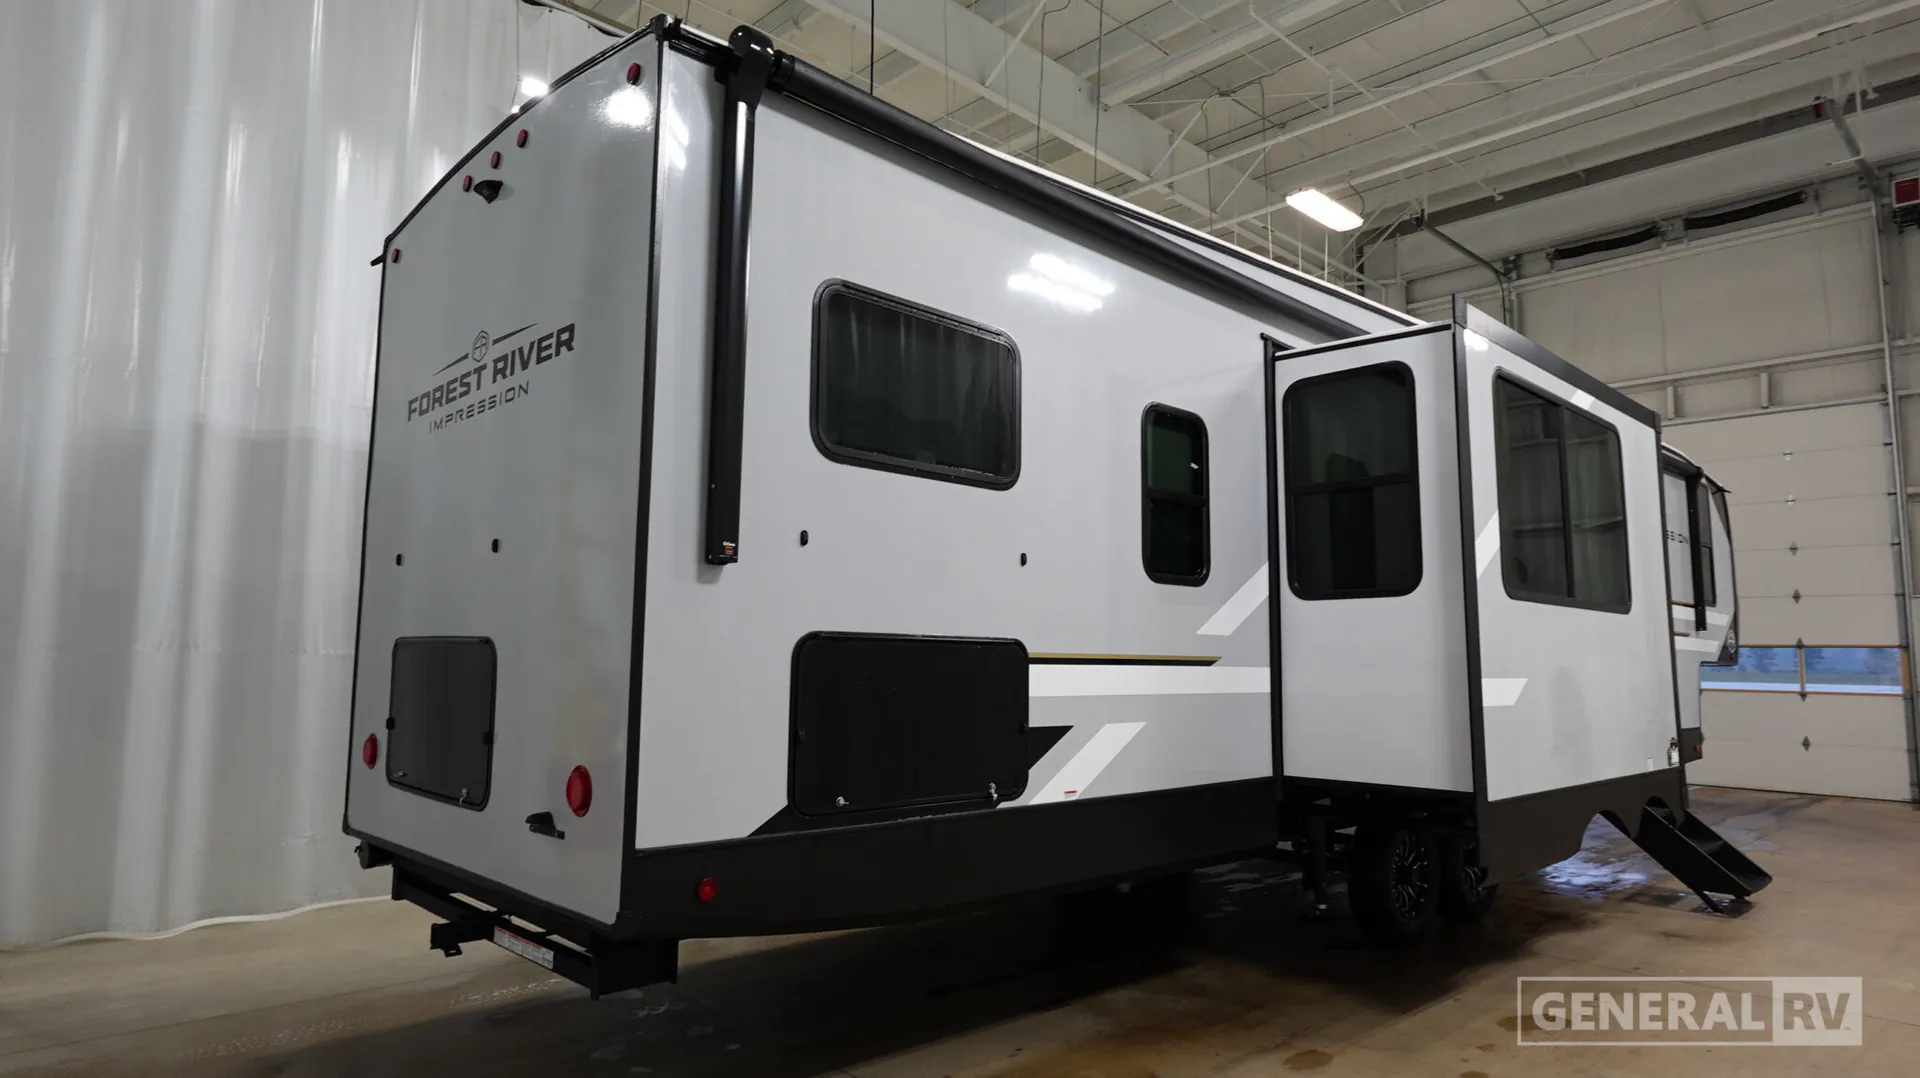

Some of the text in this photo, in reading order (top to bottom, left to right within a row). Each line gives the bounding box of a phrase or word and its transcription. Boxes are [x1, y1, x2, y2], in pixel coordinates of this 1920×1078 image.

[407, 323, 576, 422] FOREST RIVER
[428, 380, 530, 435] IMPRESSION
